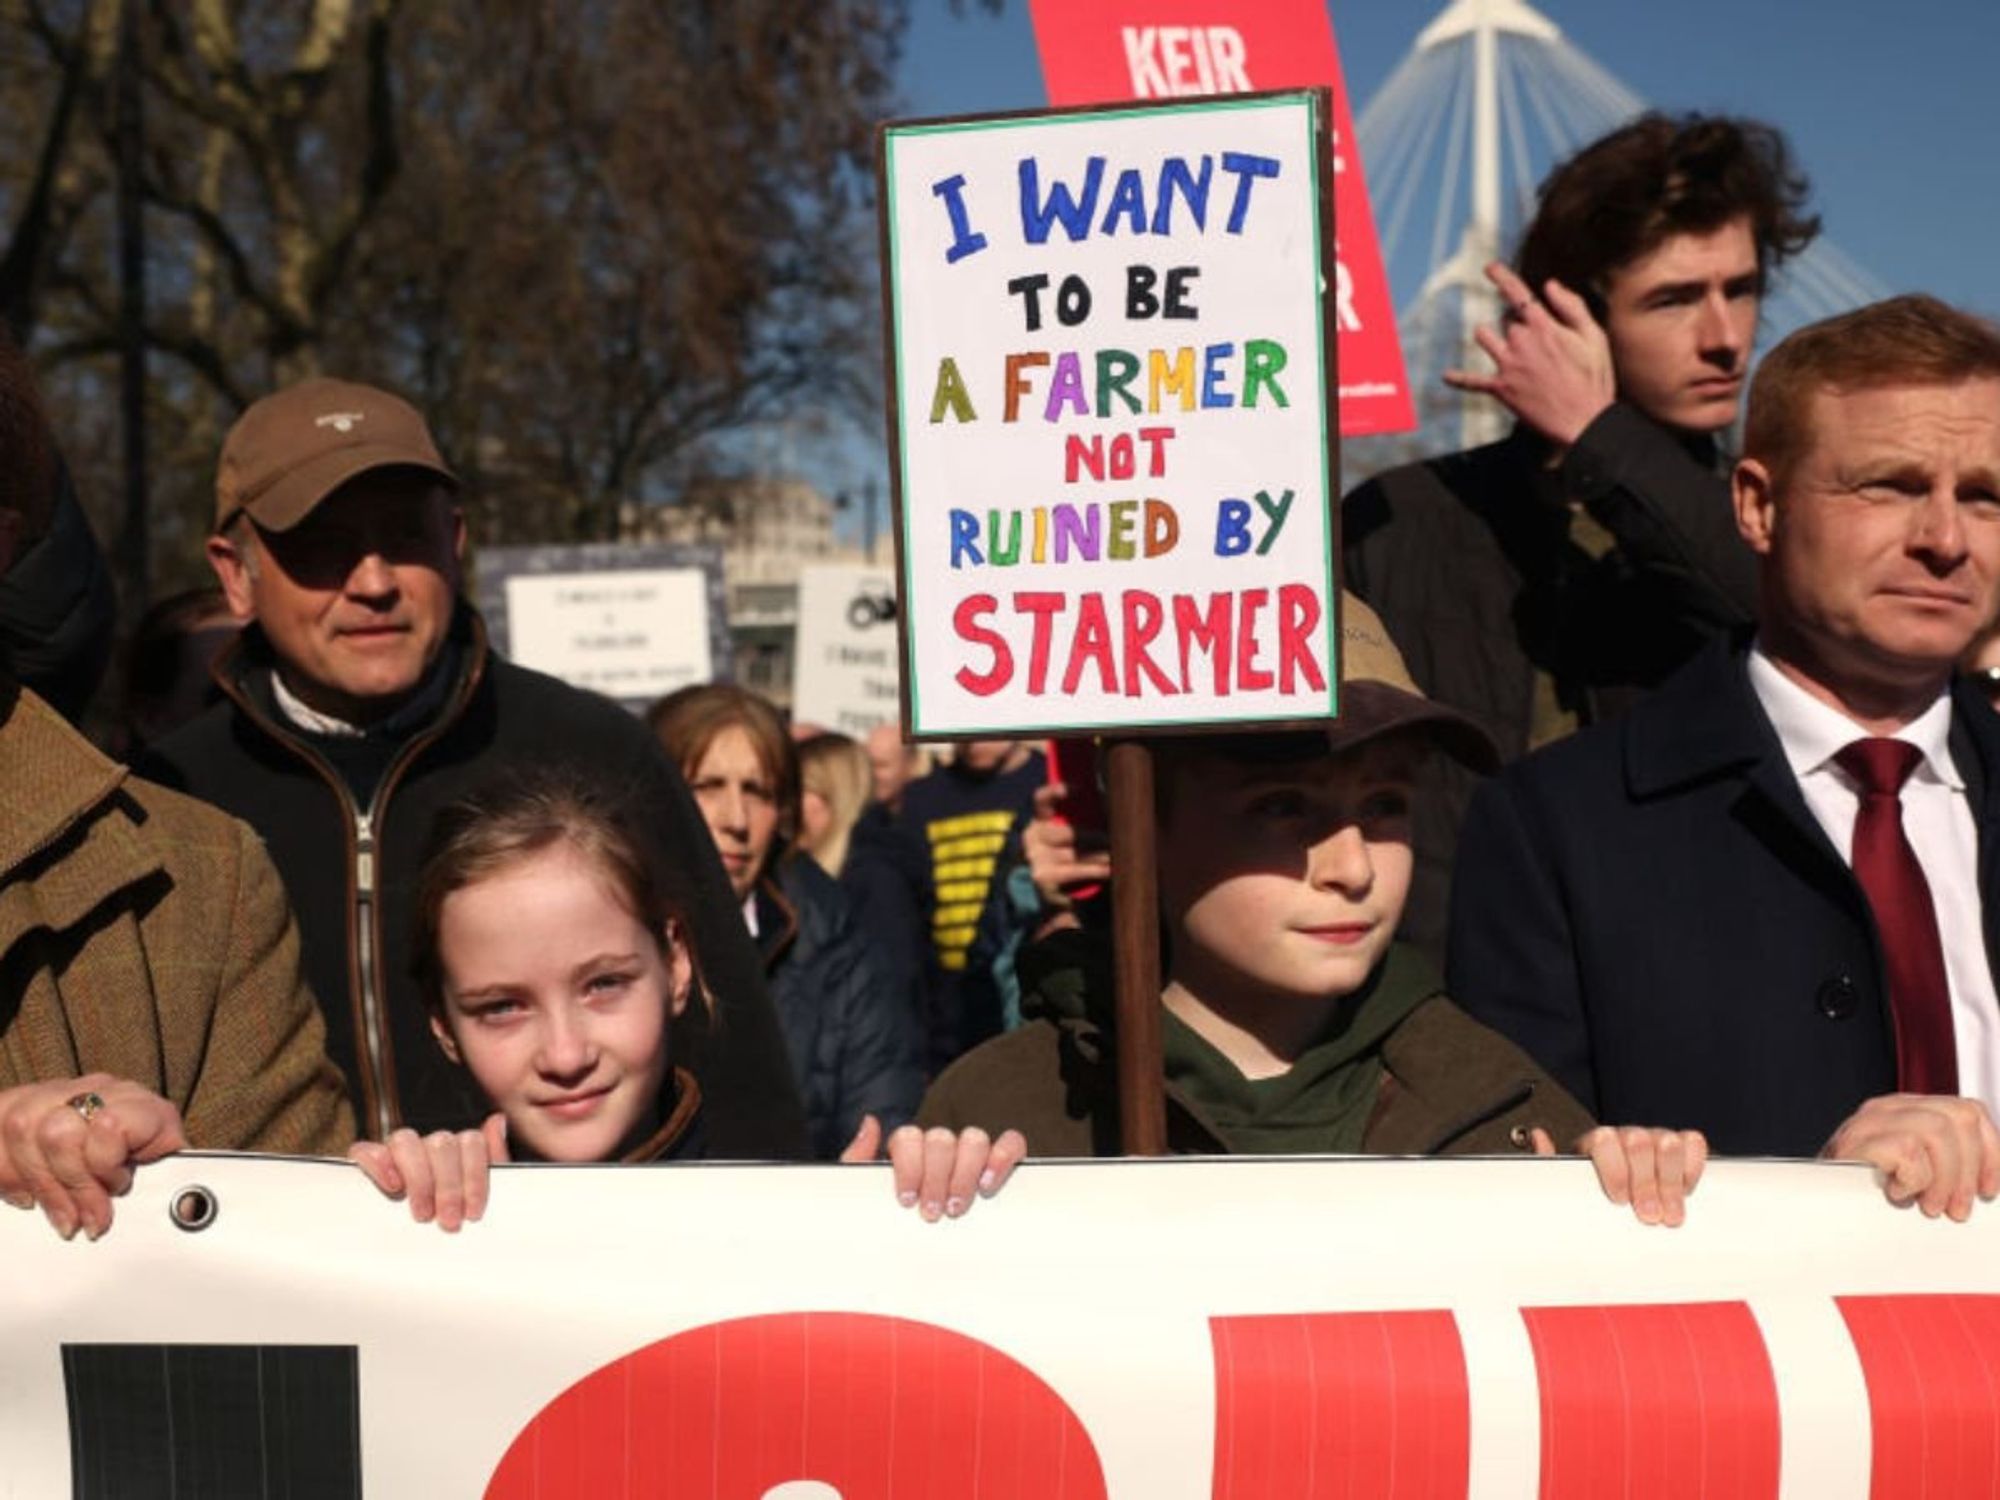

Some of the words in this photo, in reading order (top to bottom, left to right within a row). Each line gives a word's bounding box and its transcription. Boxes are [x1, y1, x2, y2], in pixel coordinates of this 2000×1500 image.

[1122, 26, 1255, 99] KEIR
[933, 174, 988, 263] I
[1018, 152, 1281, 244] WANT
[1007, 272, 1092, 331] TO
[1125, 265, 1200, 320] BE
[929, 357, 978, 423] A
[1003, 339, 1289, 423] FARMER
[1064, 427, 1176, 483] NOT
[949, 497, 1180, 569] RUINED
[1214, 490, 1295, 557] BY
[953, 583, 1327, 697] STARMER
